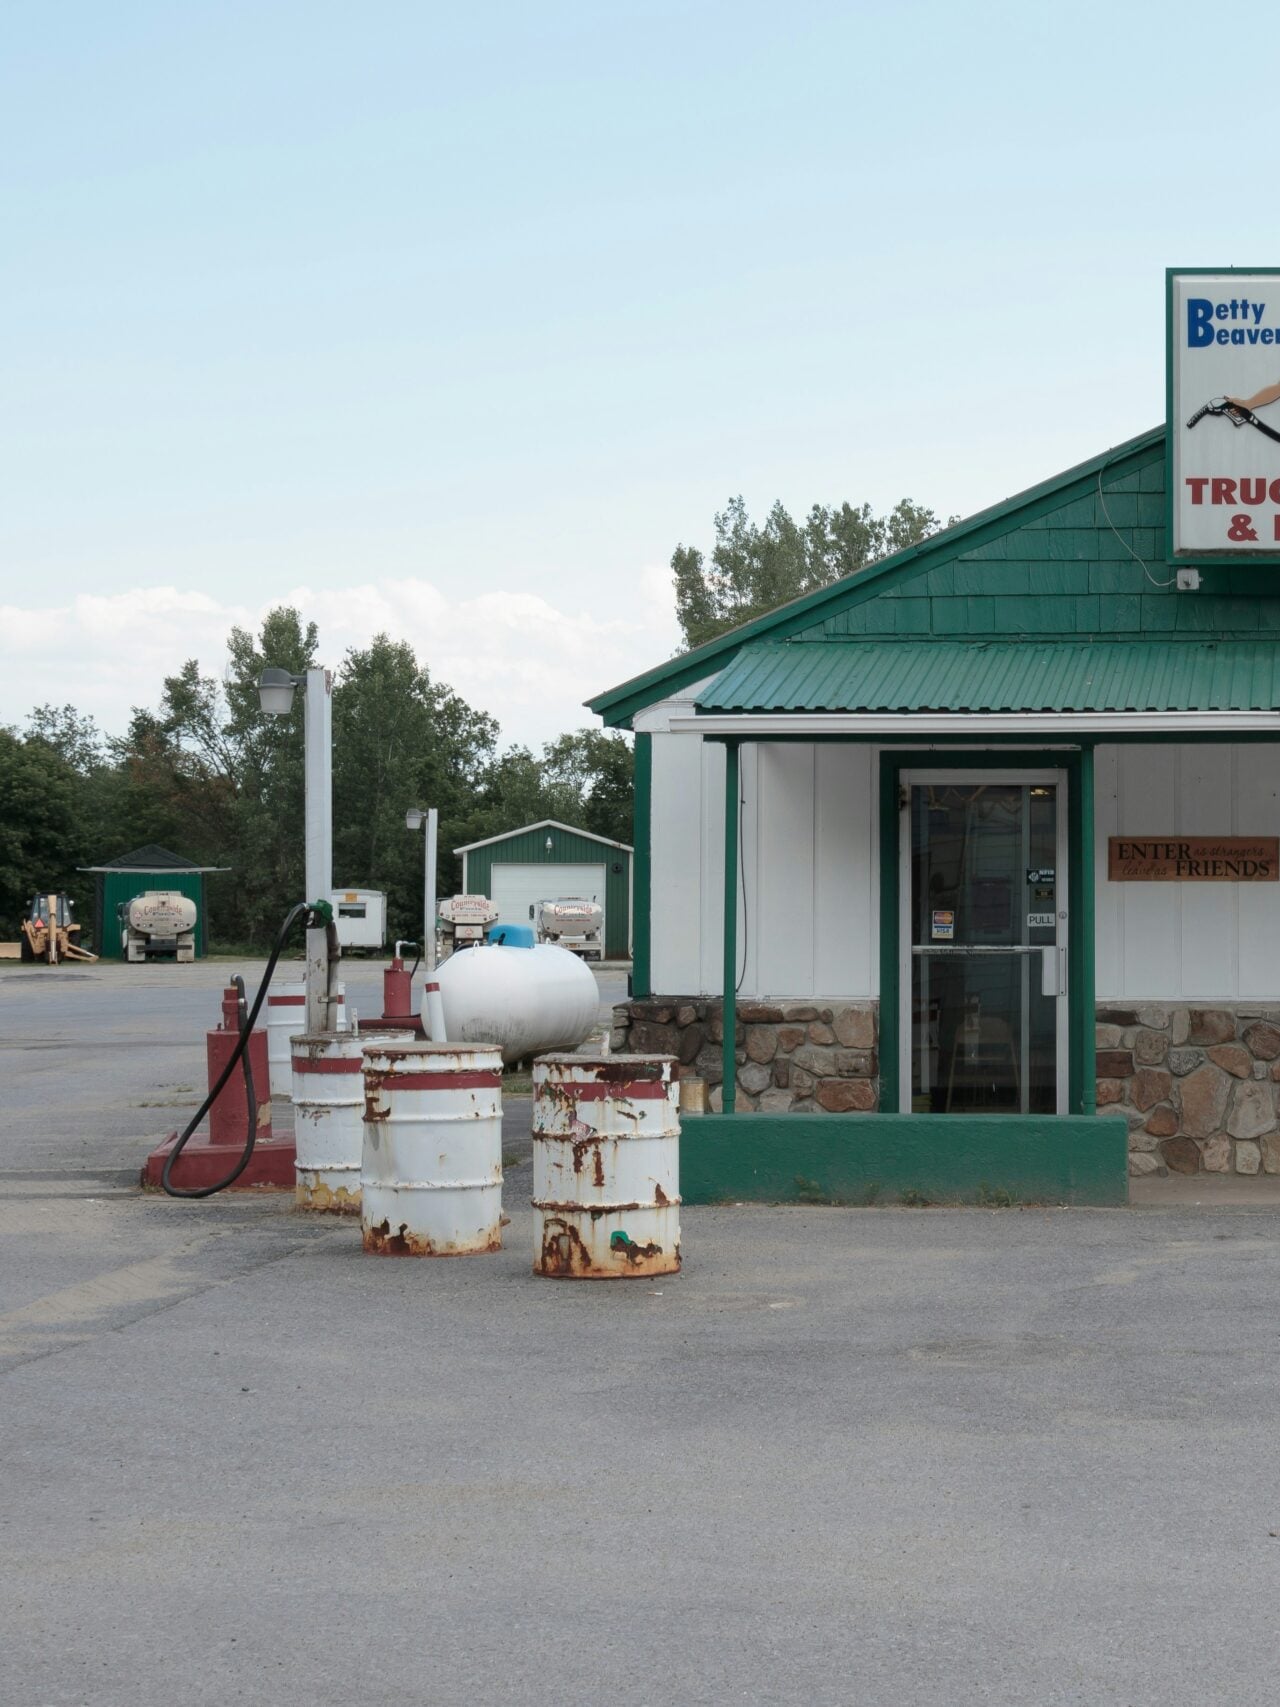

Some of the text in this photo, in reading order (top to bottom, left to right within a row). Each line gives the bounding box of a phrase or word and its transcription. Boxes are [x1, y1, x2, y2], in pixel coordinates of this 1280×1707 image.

[1187, 298, 1265, 324] Betty
[1227, 514, 1259, 542] &
[1118, 843, 1192, 860] ENTER
[1175, 860, 1271, 877] FRIENDS
[1029, 915, 1053, 925] PULL
